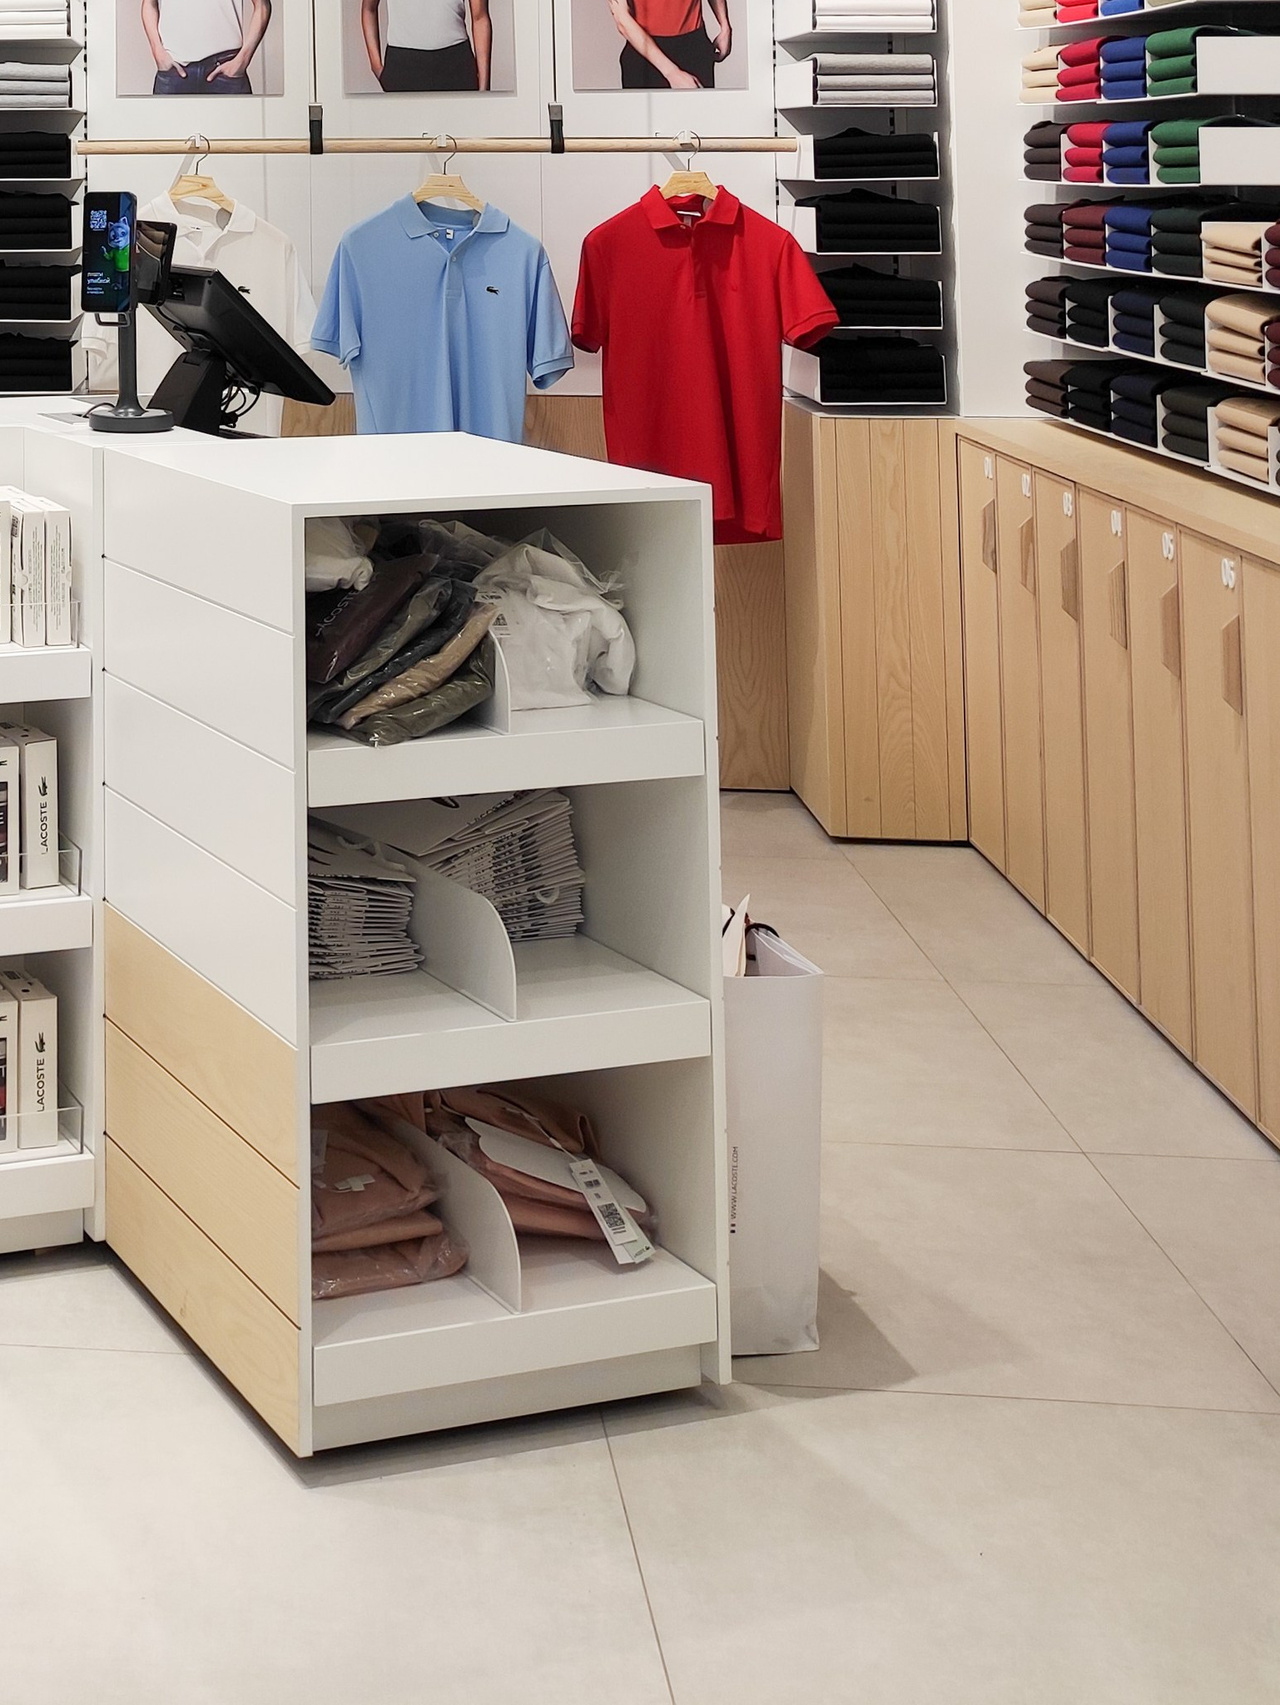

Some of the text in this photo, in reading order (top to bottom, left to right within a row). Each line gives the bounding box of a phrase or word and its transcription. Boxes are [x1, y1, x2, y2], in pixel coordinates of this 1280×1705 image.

[984, 456, 993, 480] 01
[1062, 491, 1073, 517] 03
[1110, 509, 1122, 537] 04
[1162, 532, 1174, 561] 05
[1221, 557, 1236, 589] 06
[39, 801, 48, 855] LACOSTE
[36, 1058, 45, 1112] LACOSTE
